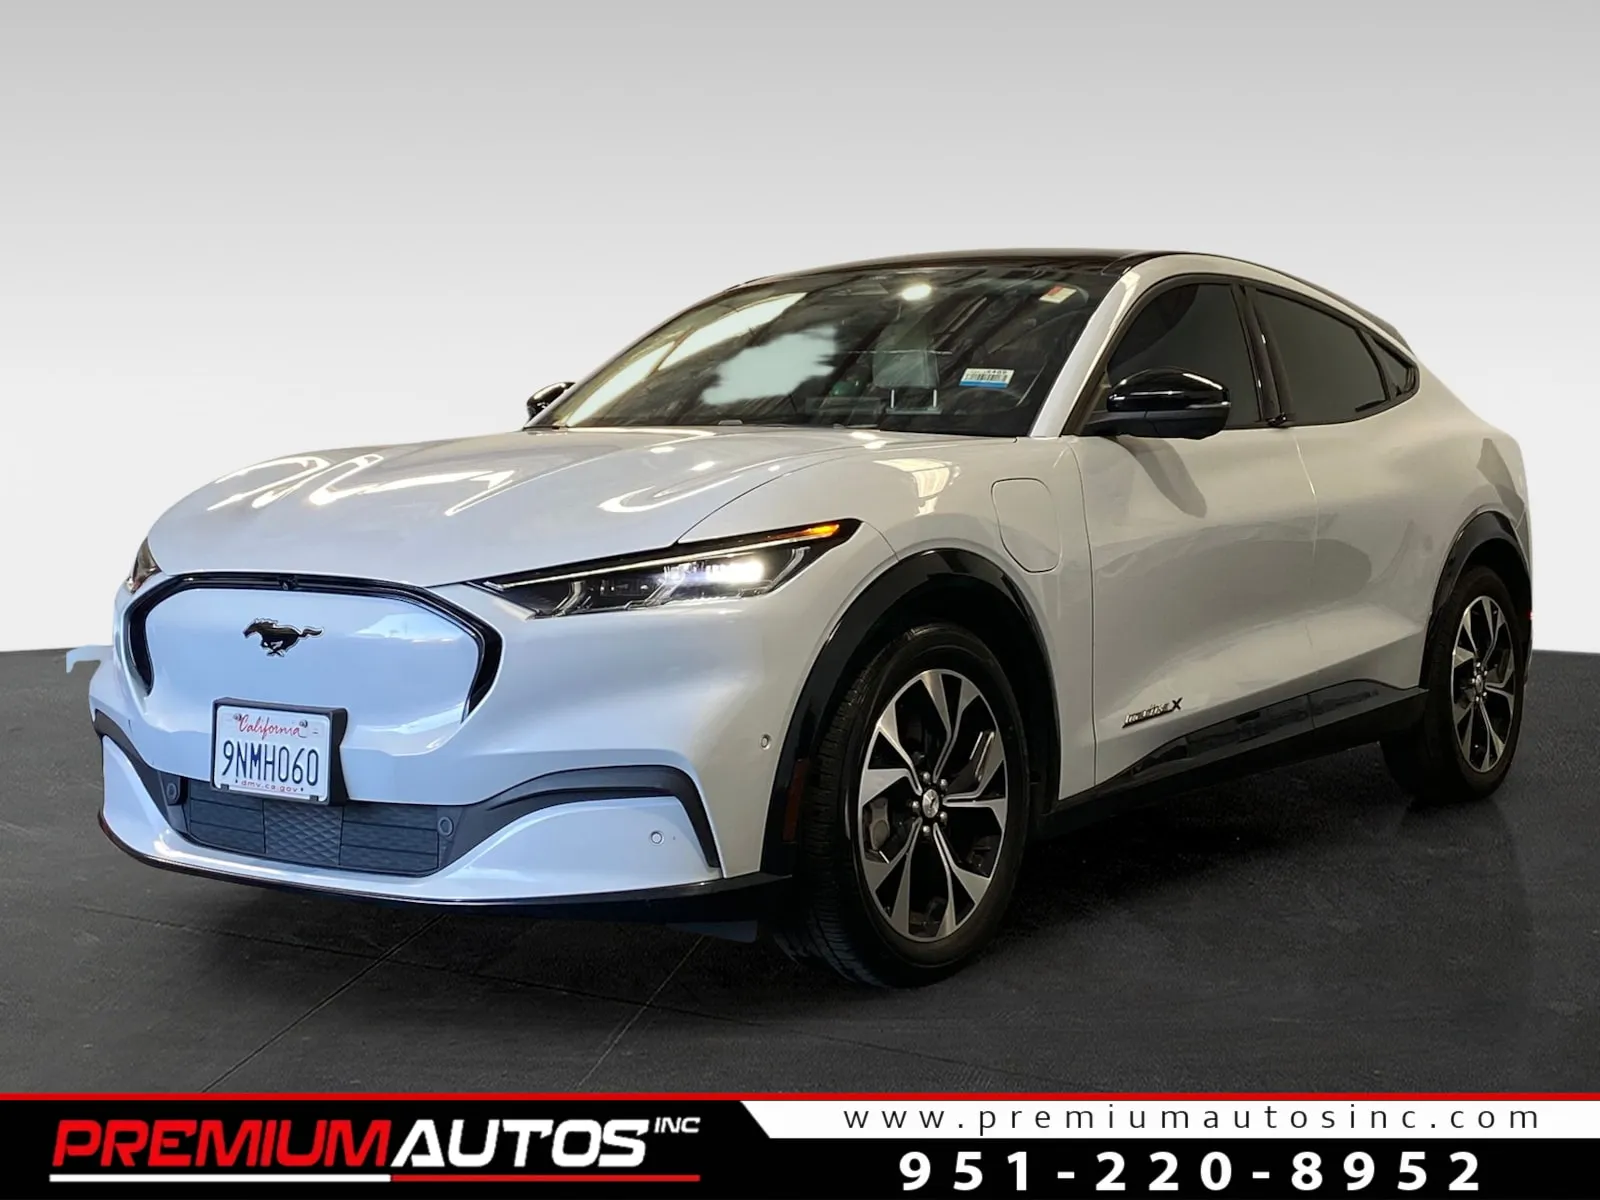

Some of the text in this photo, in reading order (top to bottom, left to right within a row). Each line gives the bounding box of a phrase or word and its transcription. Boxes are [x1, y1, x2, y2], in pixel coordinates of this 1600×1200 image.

[238, 714, 306, 740] California
[222, 740, 319, 786] 9NMH060
[241, 780, 298, 792] dmv.ca.gov
